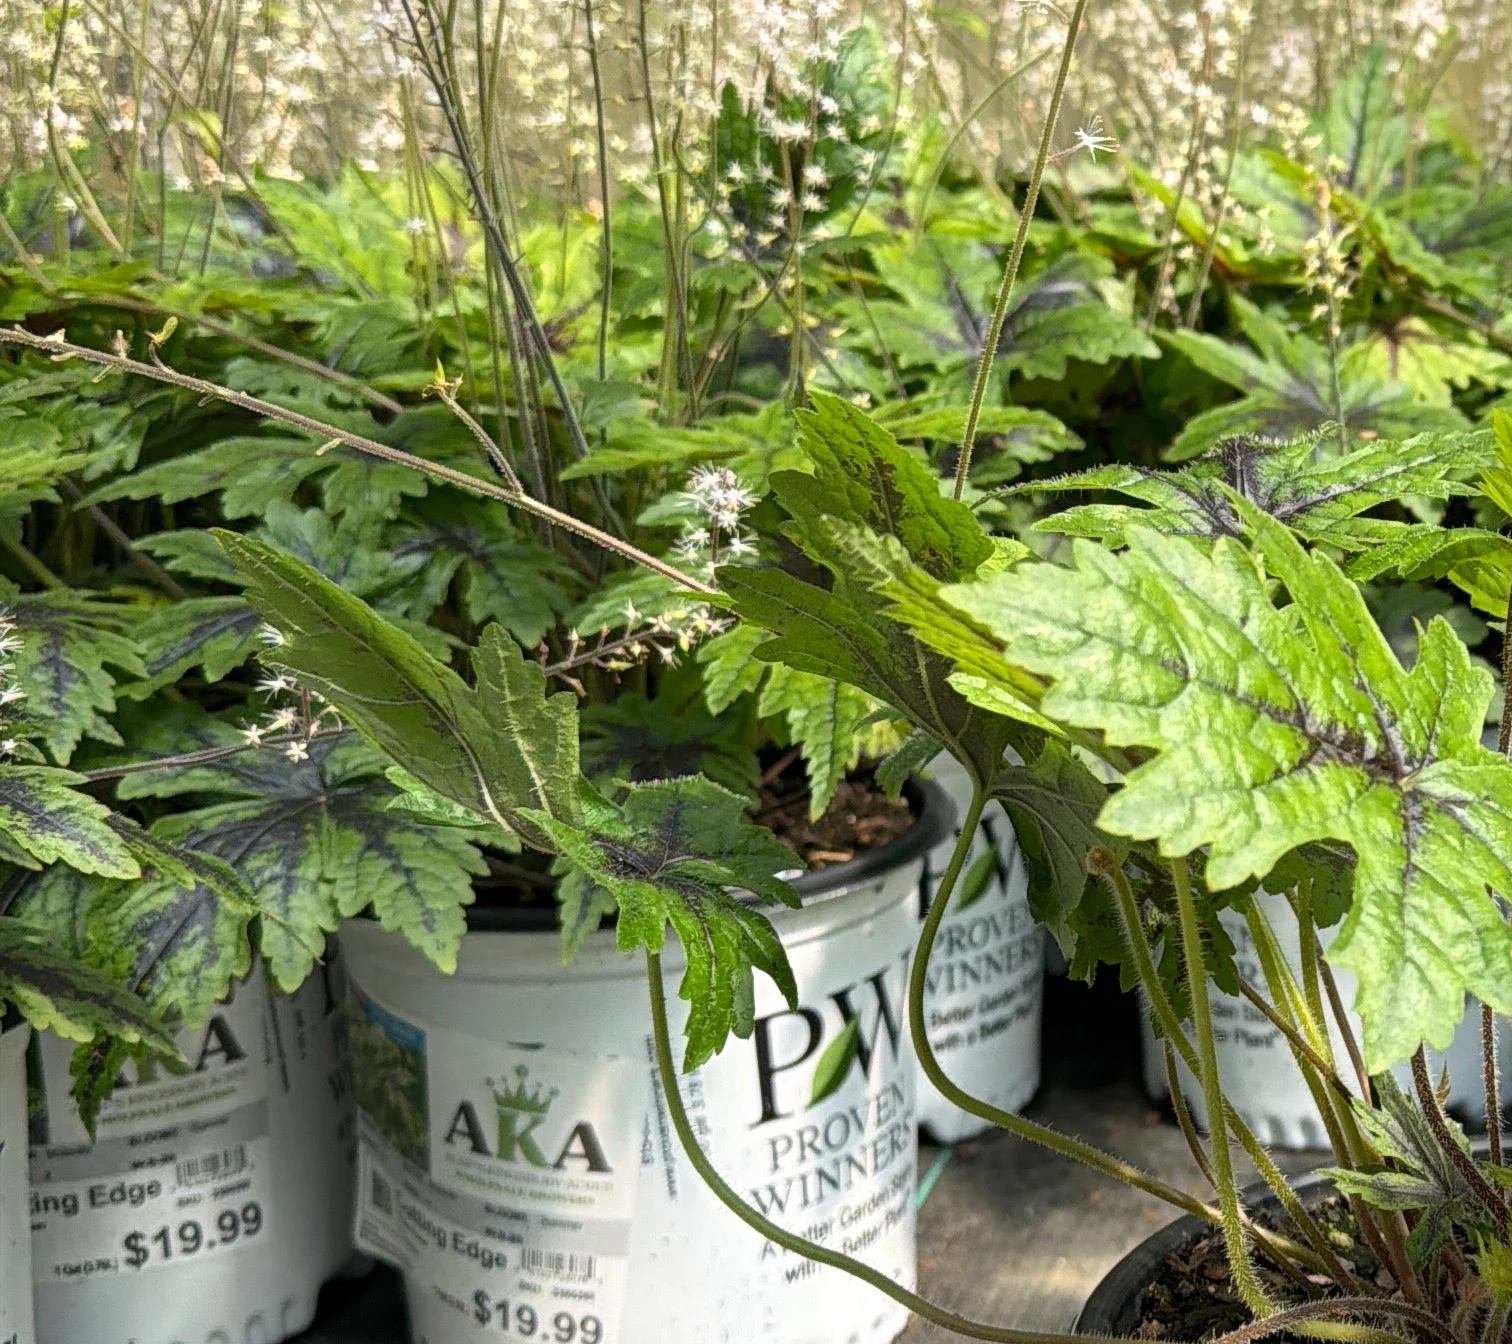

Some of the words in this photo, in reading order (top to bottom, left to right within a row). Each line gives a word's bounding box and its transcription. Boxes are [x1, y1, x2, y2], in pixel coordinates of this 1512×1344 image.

[750, 946, 912, 1130] PW
[444, 1099, 613, 1173] AKA
[767, 1073, 905, 1174] PROVEN
[88, 1179, 162, 1208] Edge
[124, 1200, 263, 1271] $19.99
[452, 1230, 507, 1271] Edge
